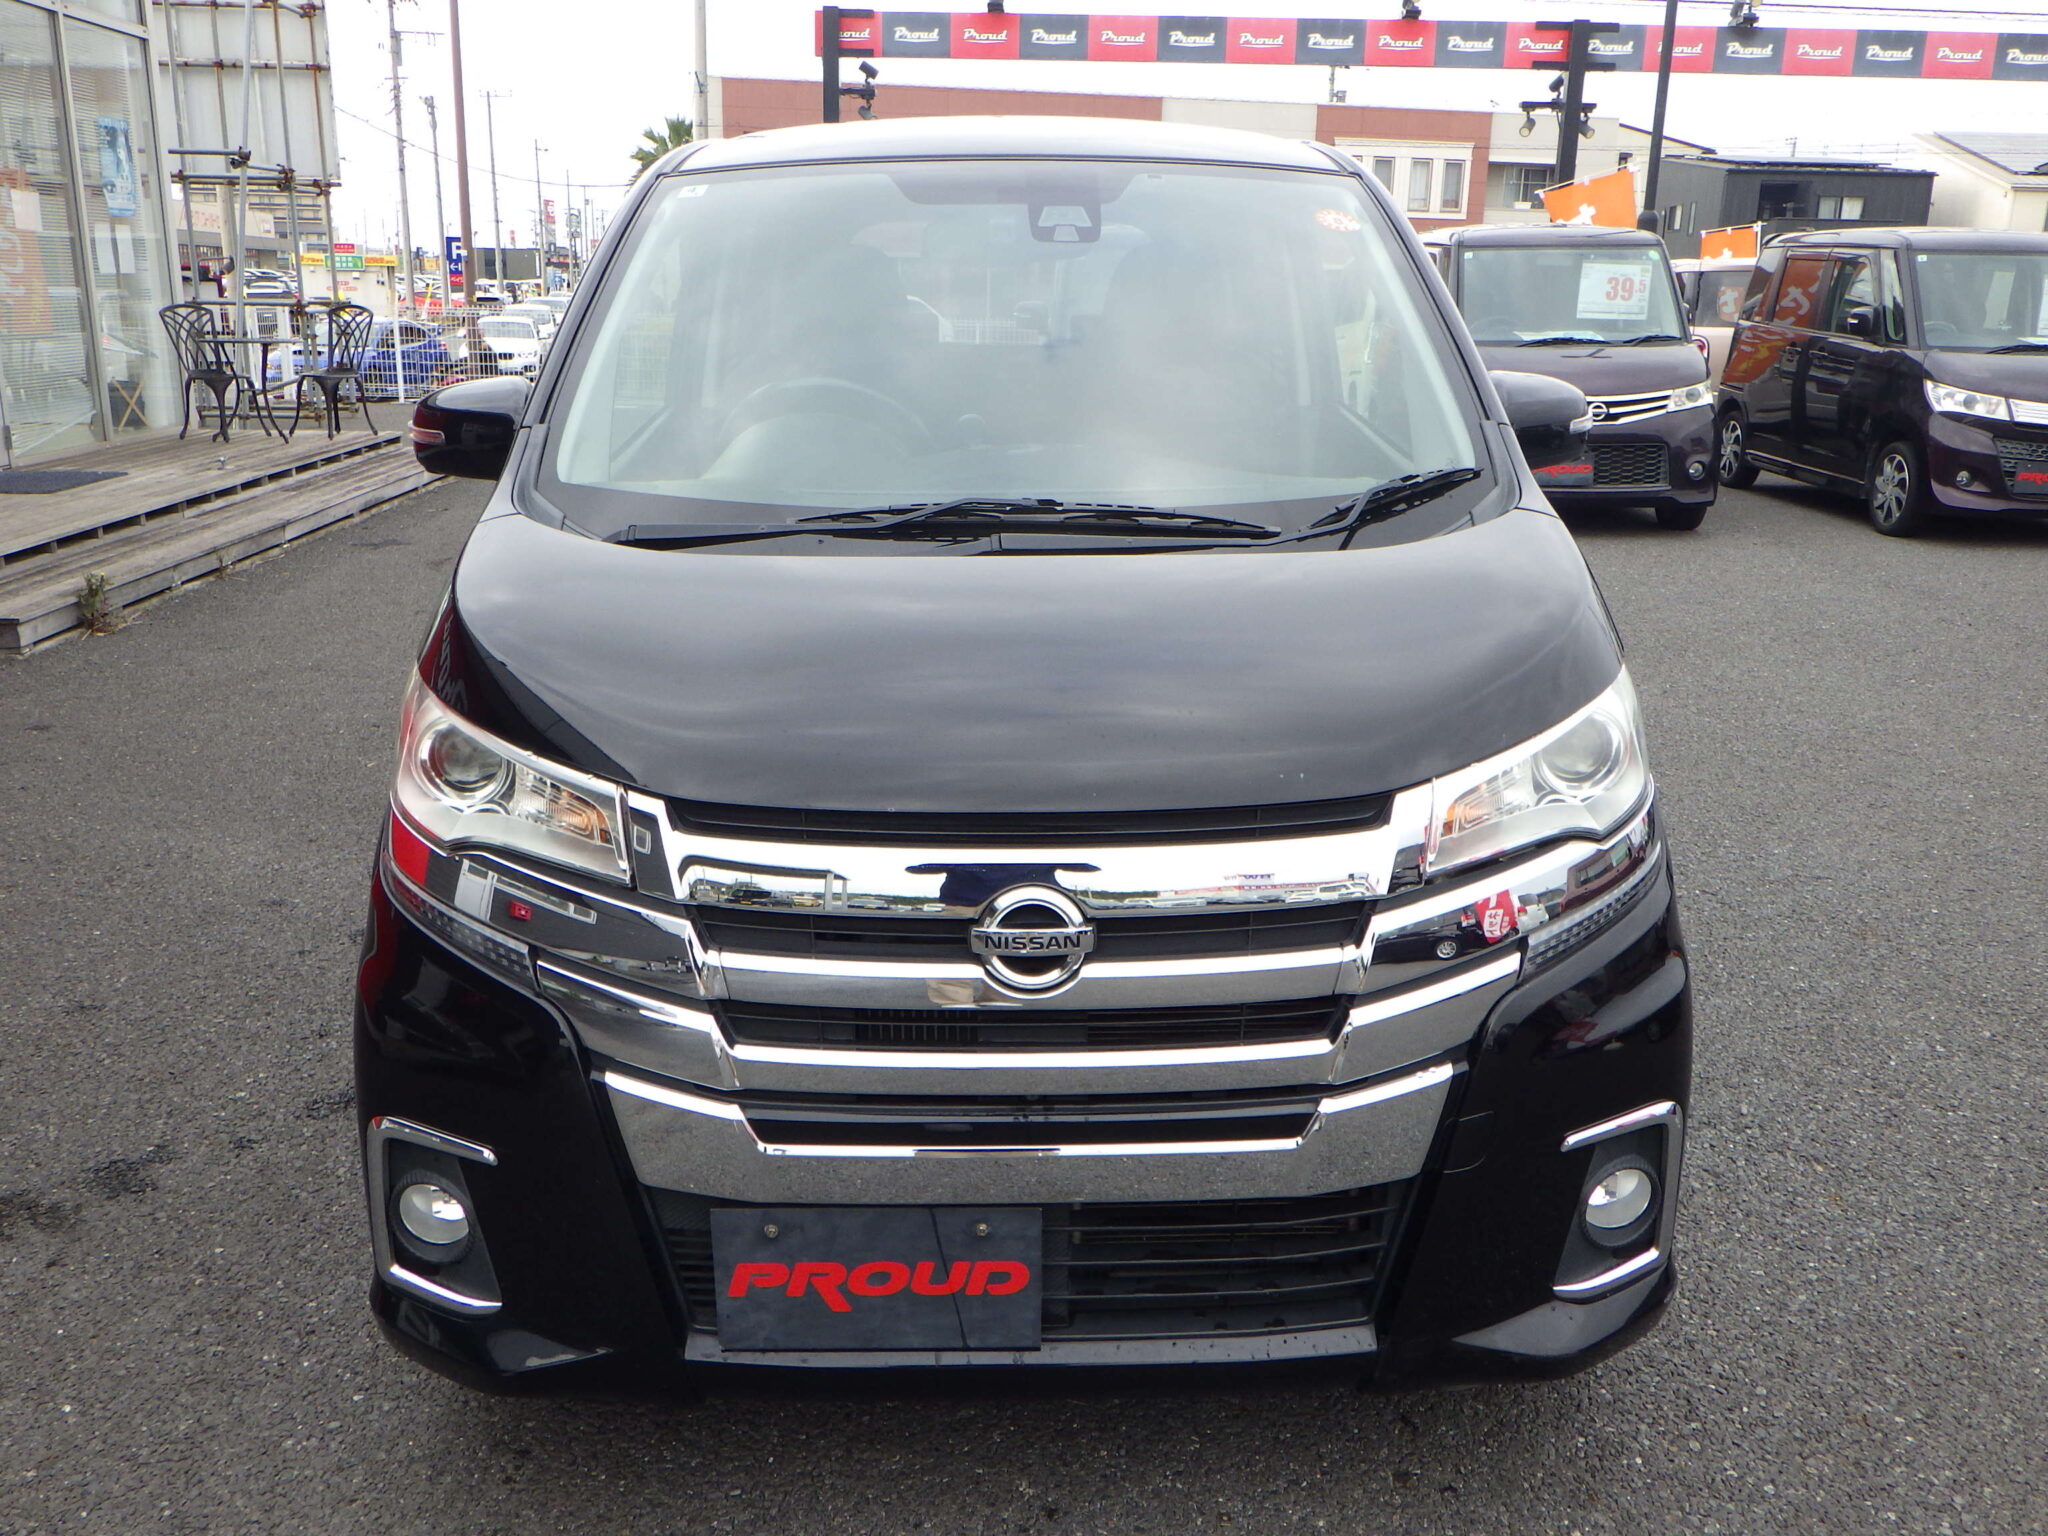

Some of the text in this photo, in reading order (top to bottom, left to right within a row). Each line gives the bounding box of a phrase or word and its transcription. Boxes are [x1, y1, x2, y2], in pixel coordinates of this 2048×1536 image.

[893, 27, 939, 41] Proud
[963, 28, 1008, 42] Proud
[1031, 29, 1077, 43] Proud
[1101, 30, 1146, 44] Proud
[1169, 31, 1215, 45] Proud
[1239, 32, 1284, 46] Proud
[1307, 33, 1354, 48] Proud
[1378, 35, 1423, 48] Proud
[1447, 36, 1494, 50] Proud
[1518, 38, 1563, 51] Proud
[1588, 38, 1634, 53] Proud
[1726, 42, 1773, 57] Proud
[1797, 43, 1842, 58] Proud
[1865, 45, 1914, 60] Proud
[1936, 47, 1983, 61] Proud
[985, 935, 1080, 950] NISSAN
[727, 1260, 1031, 1313] PROUD
